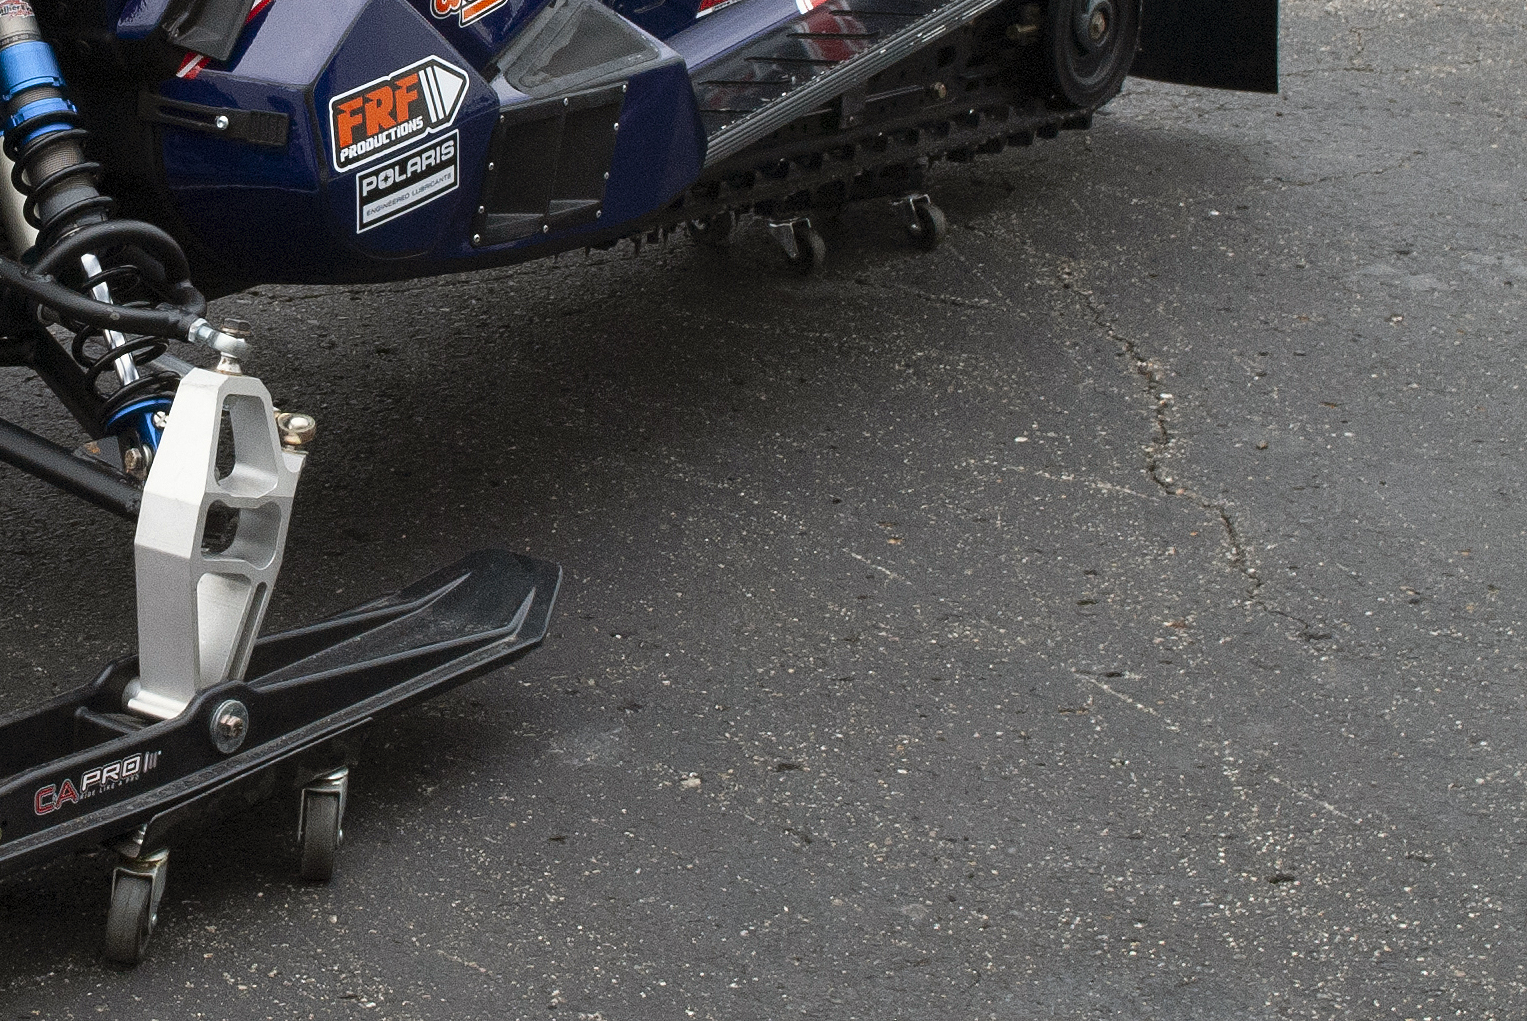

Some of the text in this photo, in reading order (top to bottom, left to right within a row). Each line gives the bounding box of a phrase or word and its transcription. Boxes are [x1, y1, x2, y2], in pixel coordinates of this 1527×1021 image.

[337, 73, 419, 149] FRF
[362, 139, 455, 197] POLARIS
[366, 172, 452, 217] ENGINEERED LUBRICANTS
[80, 753, 142, 793] PRO
